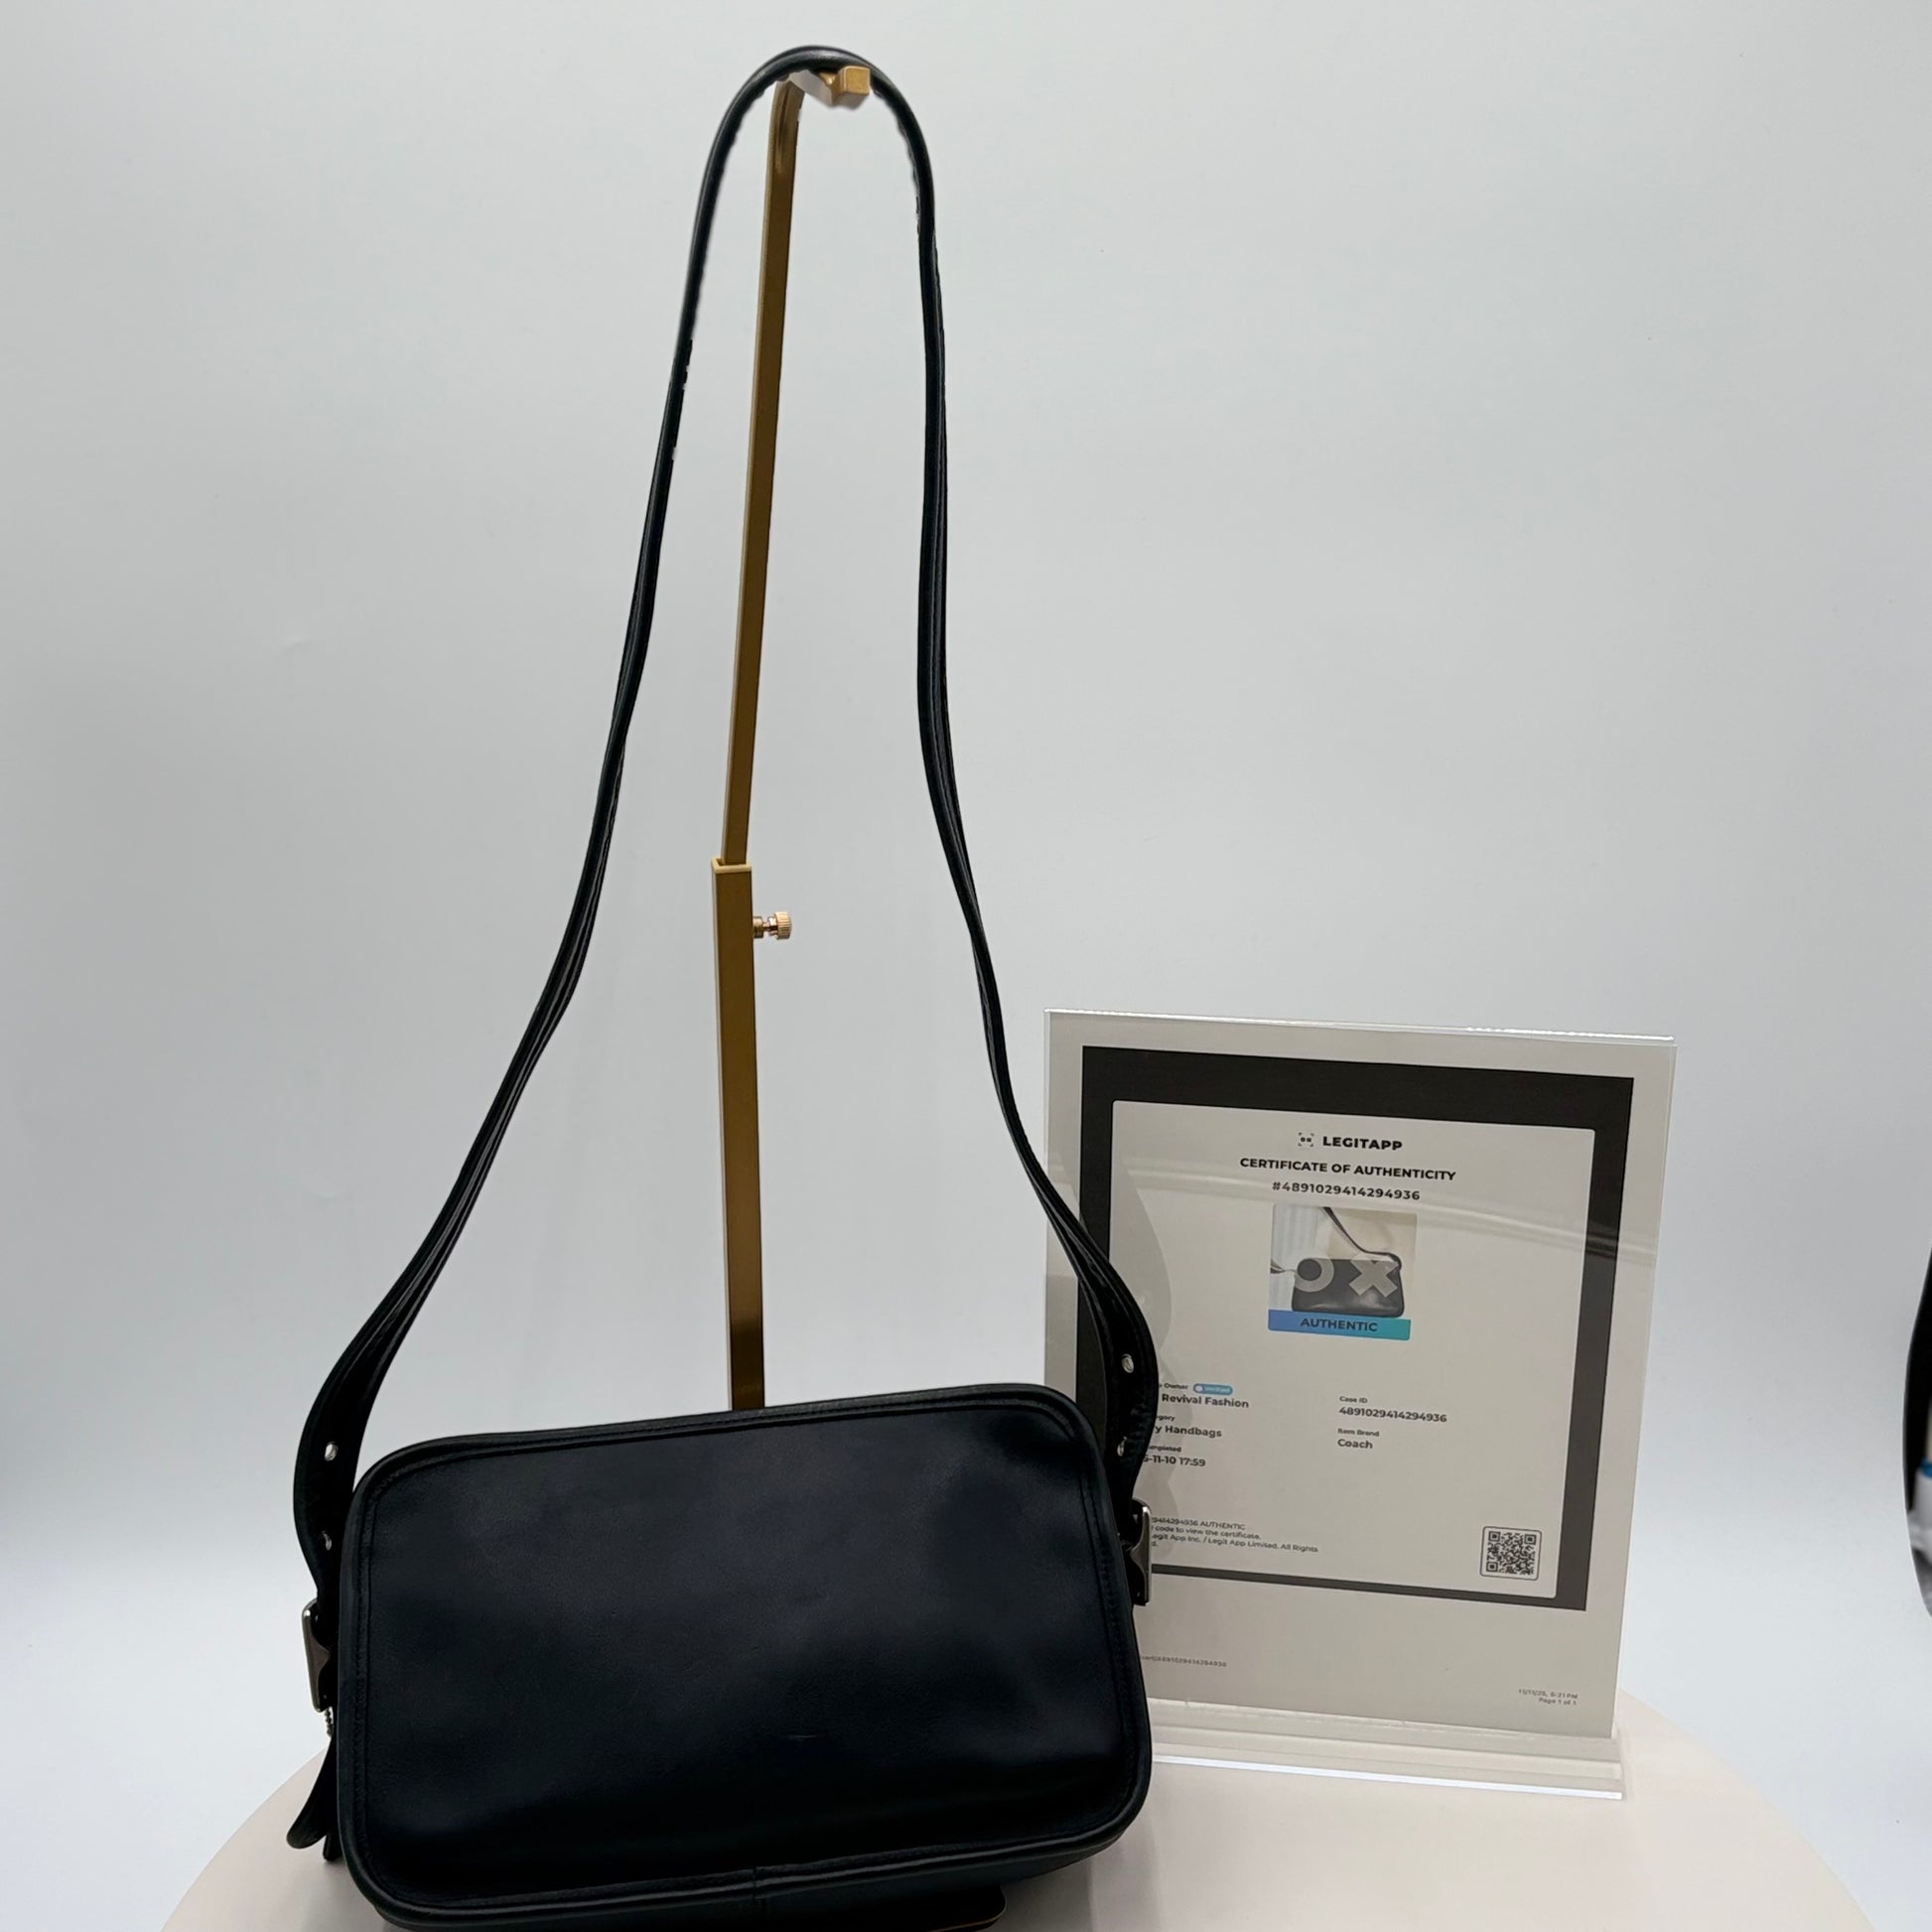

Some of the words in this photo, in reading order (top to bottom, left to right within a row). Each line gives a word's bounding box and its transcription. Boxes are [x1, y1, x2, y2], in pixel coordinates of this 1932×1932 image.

[1322, 1136, 1403, 1152] LEGITAPP
[1239, 1157, 1327, 1173] CERTIFICATE
[1330, 1163, 1350, 1174] OF
[1353, 1166, 1456, 1181] AUTHENTICITY
[1272, 1180, 1421, 1200] #4891029414294936
[1301, 1316, 1378, 1332] AUTHENTIC
[1162, 1393, 1201, 1405] Revival
[1204, 1396, 1249, 1409] Fashion
[1339, 1407, 1447, 1422] 4891029414294936
[1165, 1425, 1222, 1439] Handbags
[1336, 1438, 1373, 1449] Coach
[1143, 1453, 1176, 1464] 5-11-10
[1179, 1456, 1206, 1467] 17:59
[1199, 1520, 1246, 1531] AUTHENTIC
